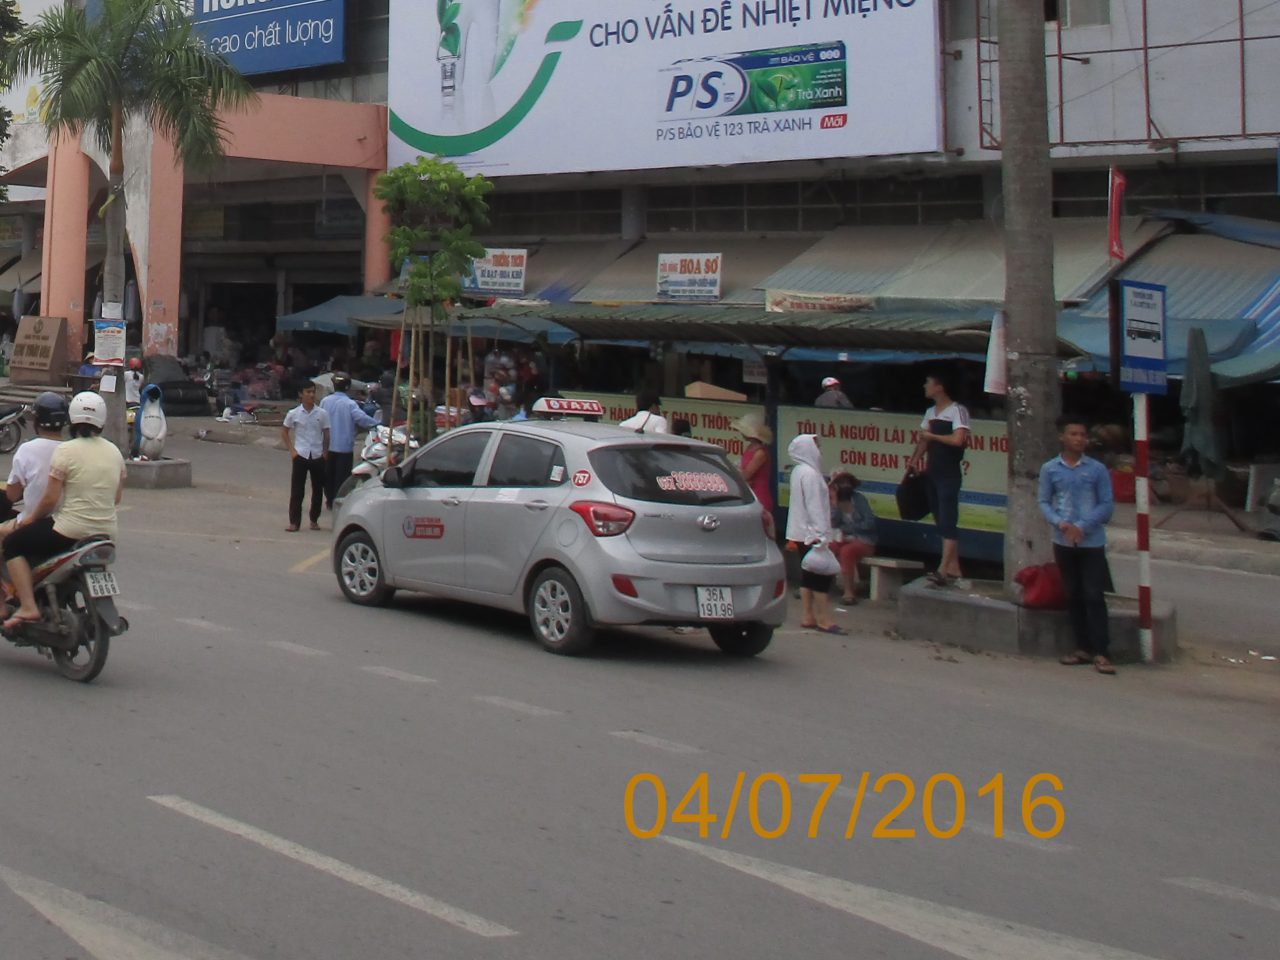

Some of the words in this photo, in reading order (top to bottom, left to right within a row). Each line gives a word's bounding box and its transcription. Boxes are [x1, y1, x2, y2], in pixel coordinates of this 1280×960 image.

[589, 17, 639, 48] CHO
[645, 2, 695, 41] VẤN
[244, 17, 281, 50] chất
[285, 18, 334, 47] lượng
[814, 86, 842, 99] Xanh
[656, 128, 675, 141] P/S
[677, 122, 703, 139] BẢO
[705, 122, 721, 140] VỆ
[723, 121, 744, 136] 123
[747, 117, 770, 134] TRÀ
[773, 117, 812, 132] XANH
[822, 116, 843, 128] Mới
[679, 258, 702, 274] HOA
[559, 400, 599, 411] TAXI
[821, 421, 836, 438] LÀ
[840, 423, 880, 441] NGƯỜI
[884, 427, 905, 444] LÁI
[840, 447, 867, 466] CÒN
[871, 451, 899, 471] BẠN
[574, 473, 590, 484] 757
[705, 588, 725, 602] 36A
[700, 602, 733, 617] 191.96
